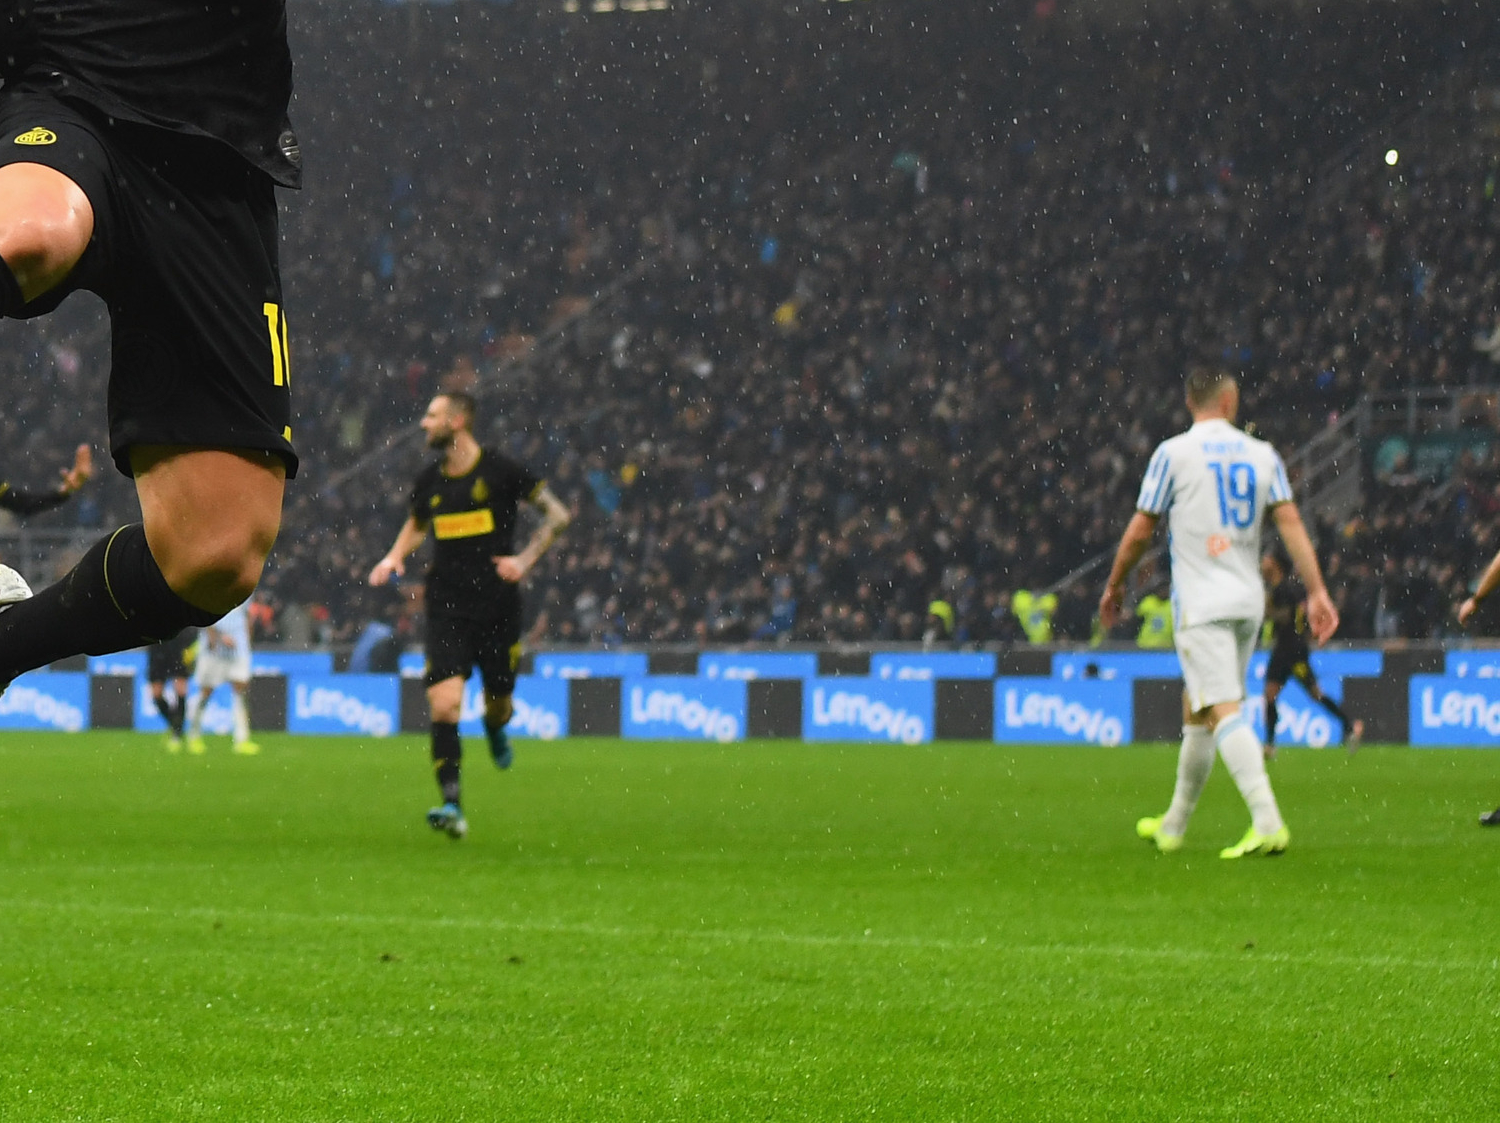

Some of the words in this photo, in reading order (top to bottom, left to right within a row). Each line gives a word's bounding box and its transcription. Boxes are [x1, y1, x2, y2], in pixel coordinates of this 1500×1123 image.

[263, 302, 291, 391] 1
[1207, 461, 1257, 530] 19
[631, 687, 740, 744] Lenovo
[812, 688, 924, 745] Lenovo
[1004, 689, 1123, 747] Lenovo
